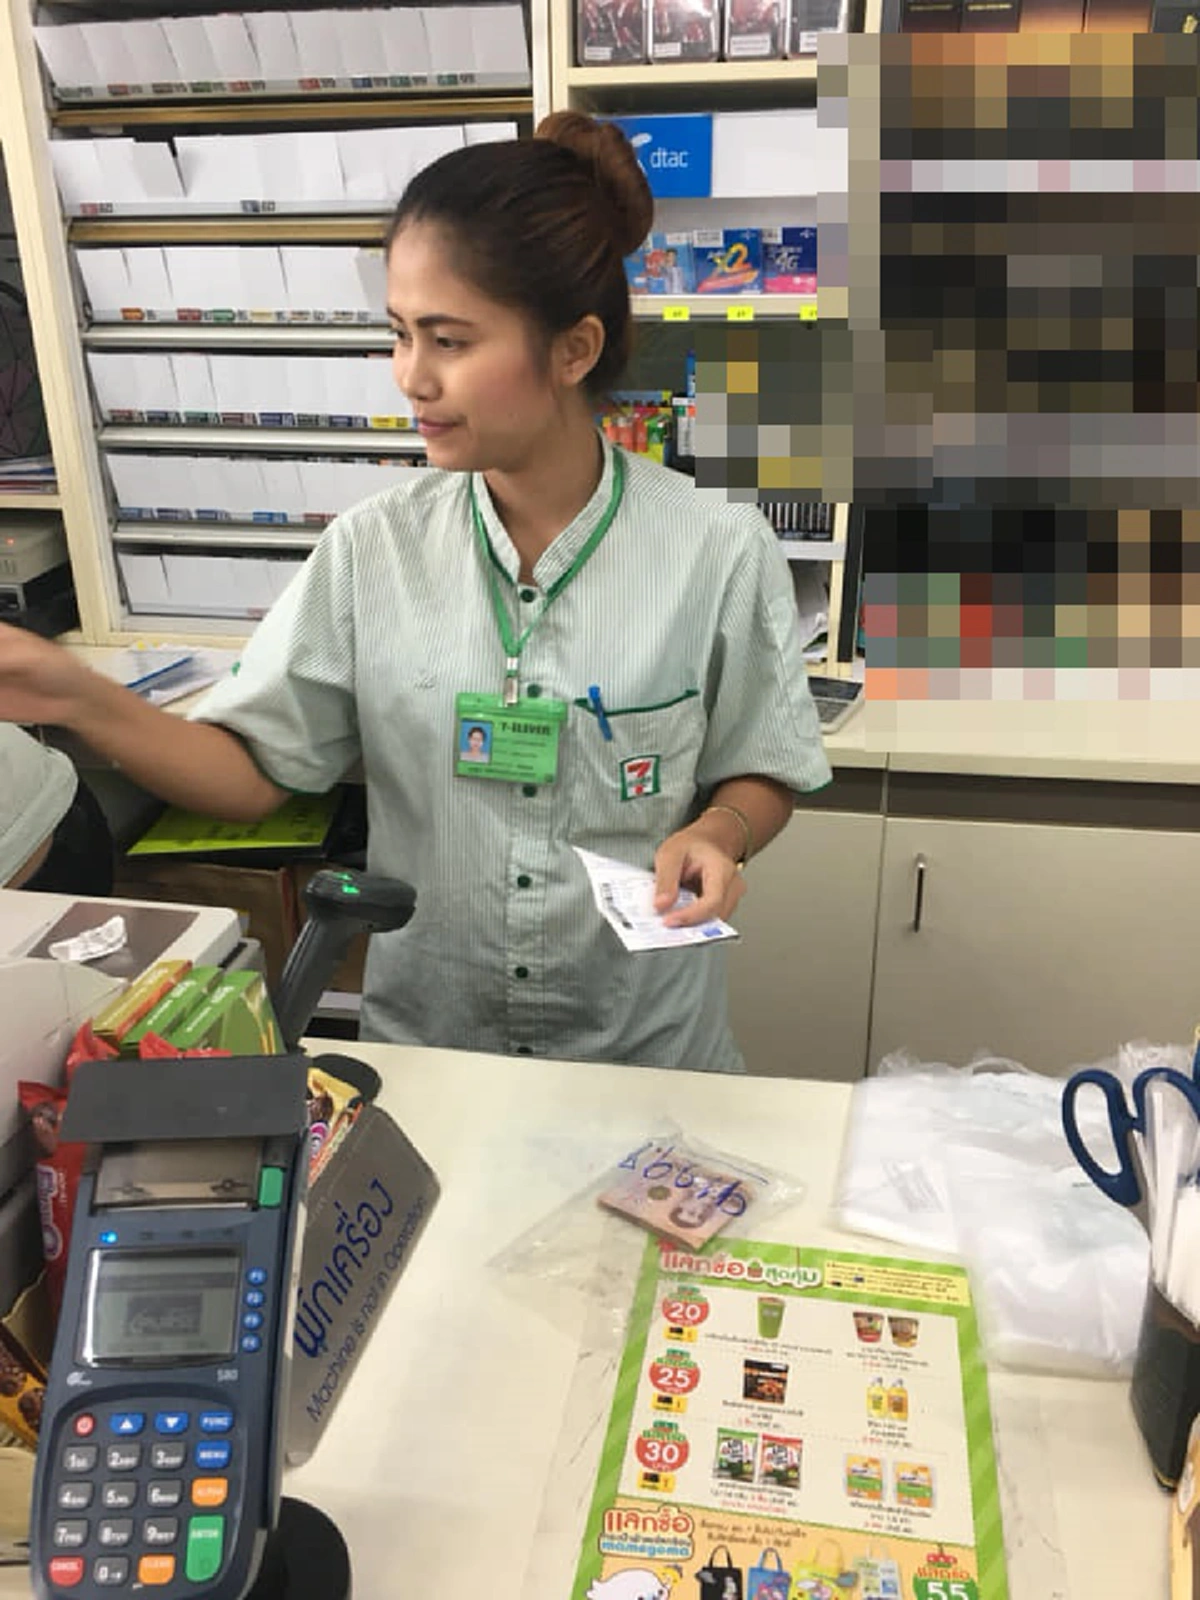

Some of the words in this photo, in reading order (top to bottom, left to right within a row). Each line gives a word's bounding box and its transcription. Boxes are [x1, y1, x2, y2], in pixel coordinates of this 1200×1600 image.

[650, 148, 689, 168] dtac
[775, 252, 799, 273] 4G
[627, 760, 651, 778] 7
[669, 1302, 702, 1320] 20
[306, 1334, 358, 1422] Machine
[361, 1288, 379, 1322] not
[657, 1367, 690, 1387] 25
[644, 1442, 680, 1463] 30
[607, 1508, 691, 1533] แลกซื้อ
[601, 1540, 690, 1557] mamegoma
[927, 1582, 972, 1600] 55
